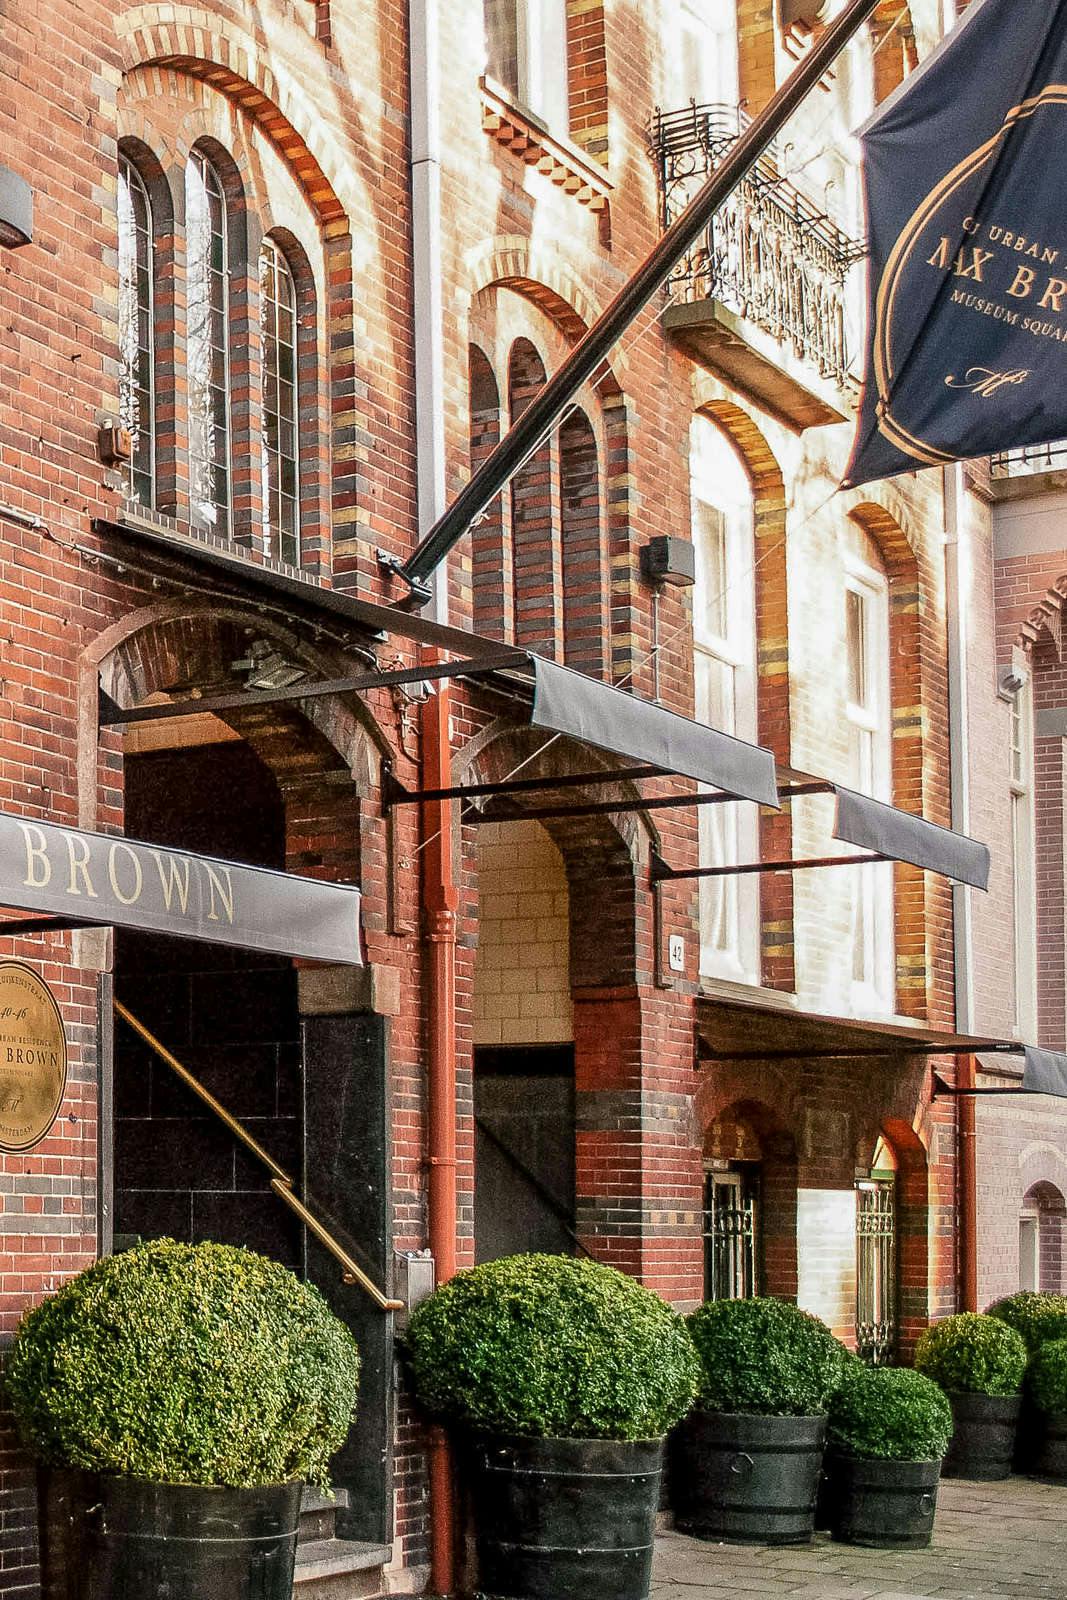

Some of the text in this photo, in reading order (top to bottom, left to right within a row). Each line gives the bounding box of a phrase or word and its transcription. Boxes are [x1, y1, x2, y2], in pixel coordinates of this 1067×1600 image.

[989, 225, 1059, 265] URBAN
[950, 289, 1019, 325] MUSEUM
[16, 822, 234, 925] BROWN
[672, 945, 682, 962] 42
[7, 1047, 58, 1067] BROWN
